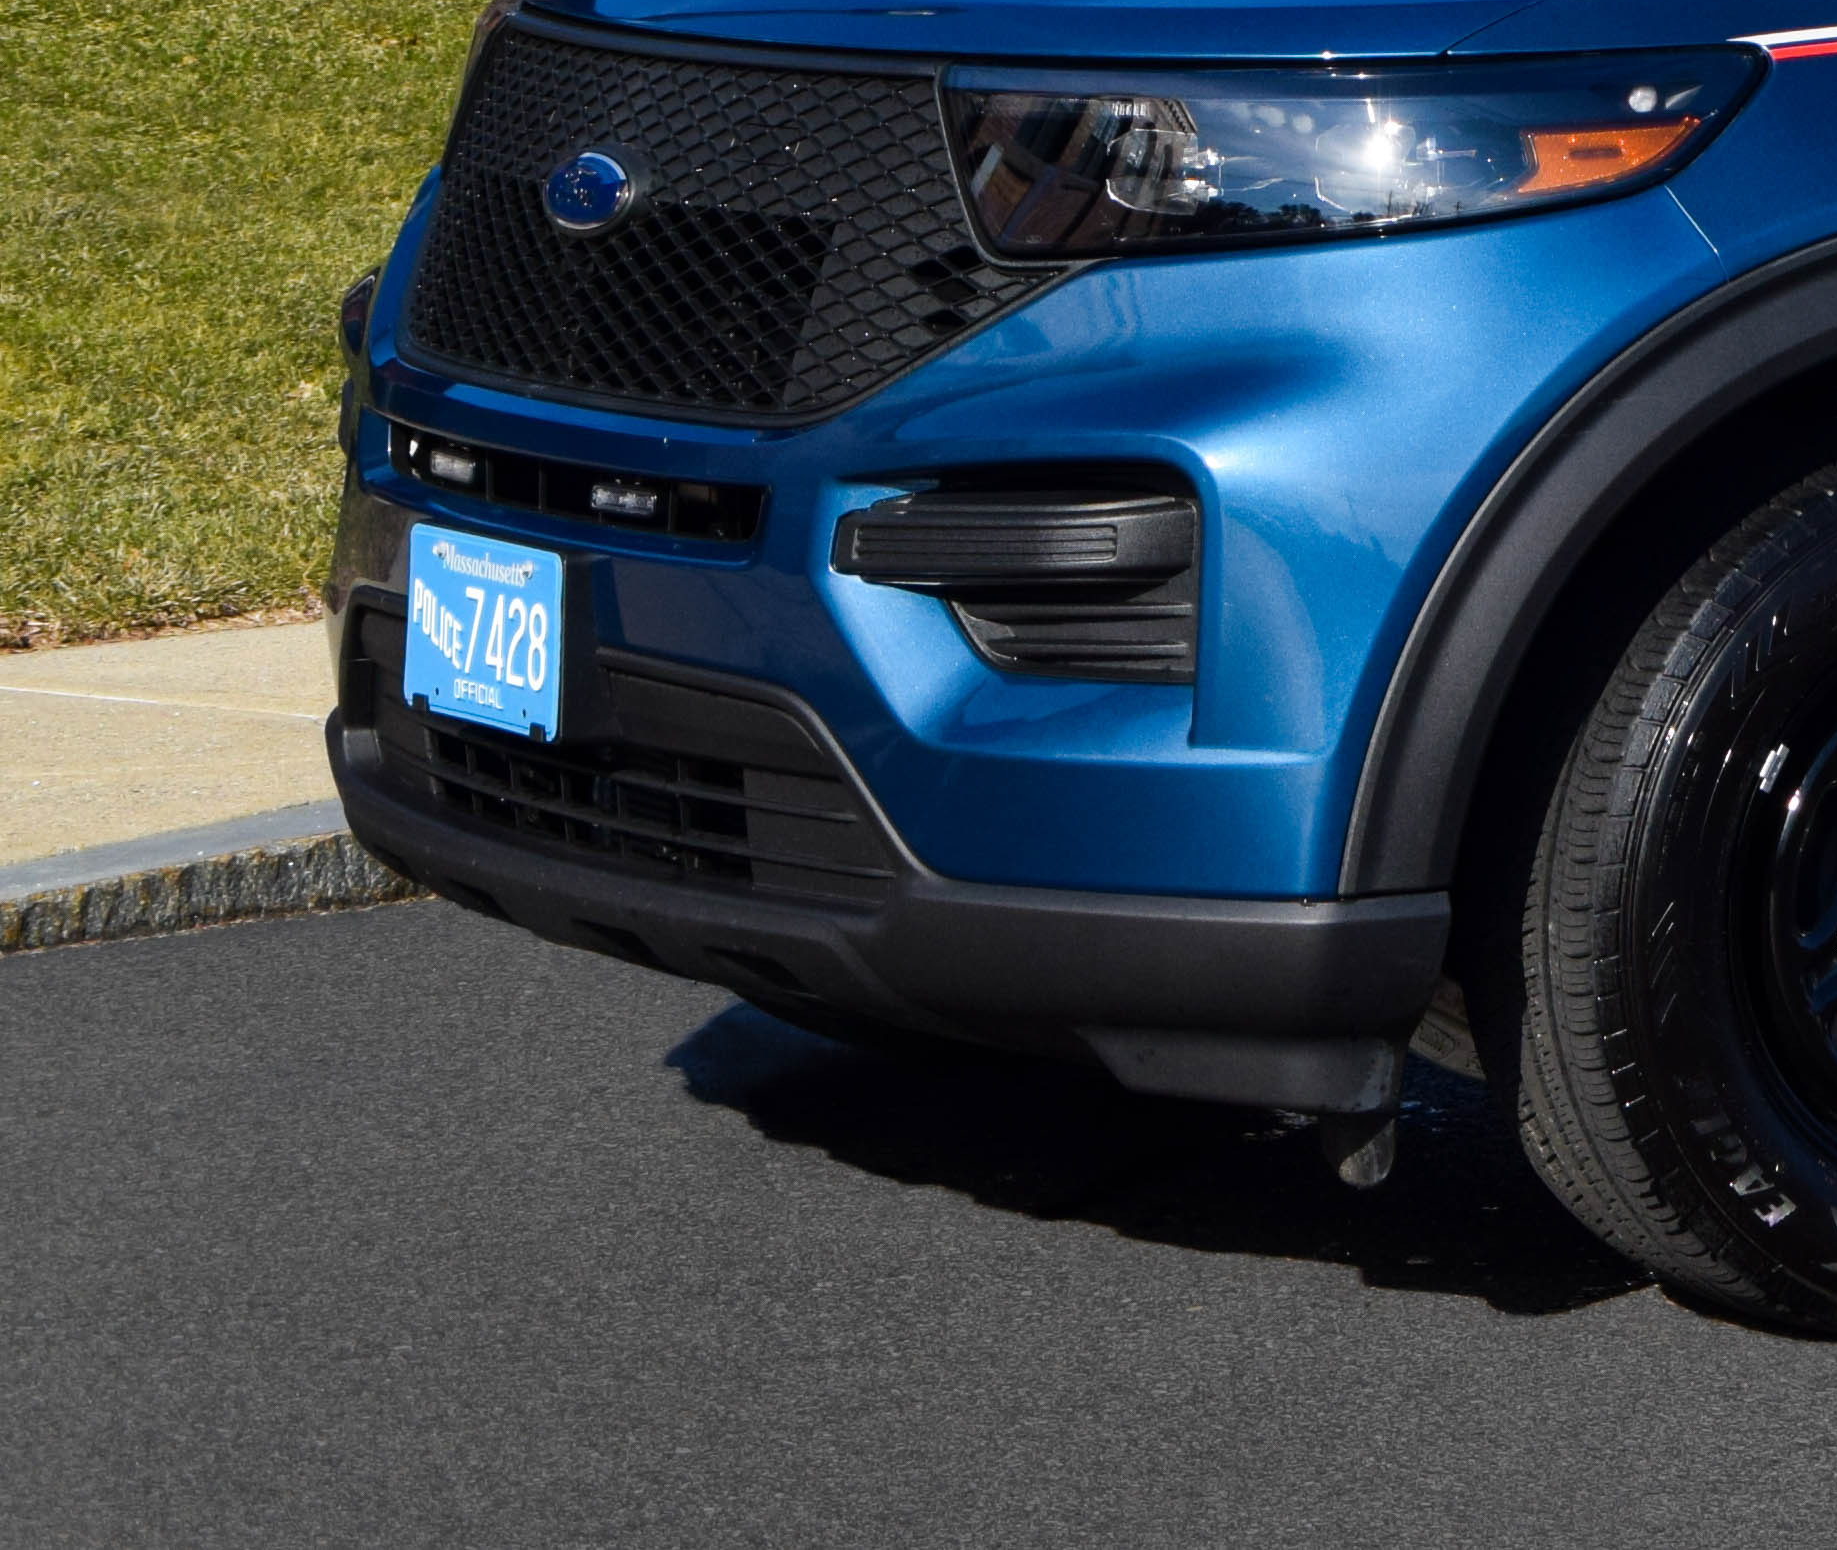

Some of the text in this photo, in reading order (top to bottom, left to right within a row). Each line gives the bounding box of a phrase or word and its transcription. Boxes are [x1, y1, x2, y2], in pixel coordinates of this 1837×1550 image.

[442, 542, 526, 587] Massachusetts
[413, 578, 547, 692] POLICE 7428
[453, 678, 504, 709] OFFICIAL
